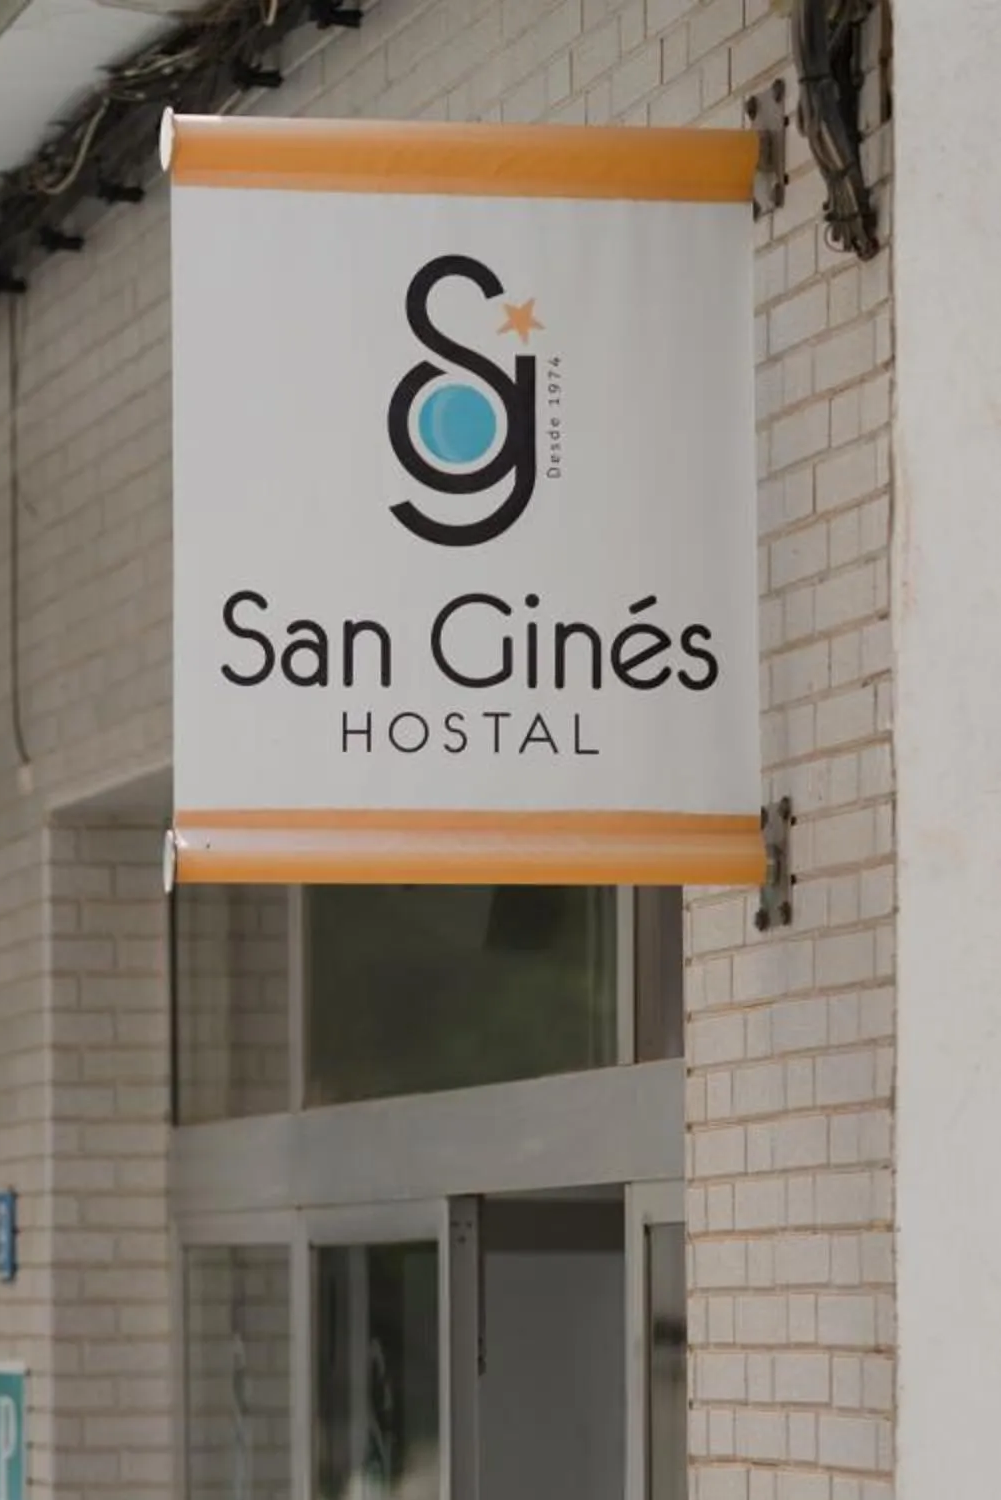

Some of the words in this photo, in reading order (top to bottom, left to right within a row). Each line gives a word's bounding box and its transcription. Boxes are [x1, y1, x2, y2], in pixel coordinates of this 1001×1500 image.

[547, 356, 562, 405] 1974
[546, 417, 562, 479] Desde
[220, 590, 392, 688] San
[430, 592, 719, 691] Ginés
[342, 711, 600, 755] HOSTAL
